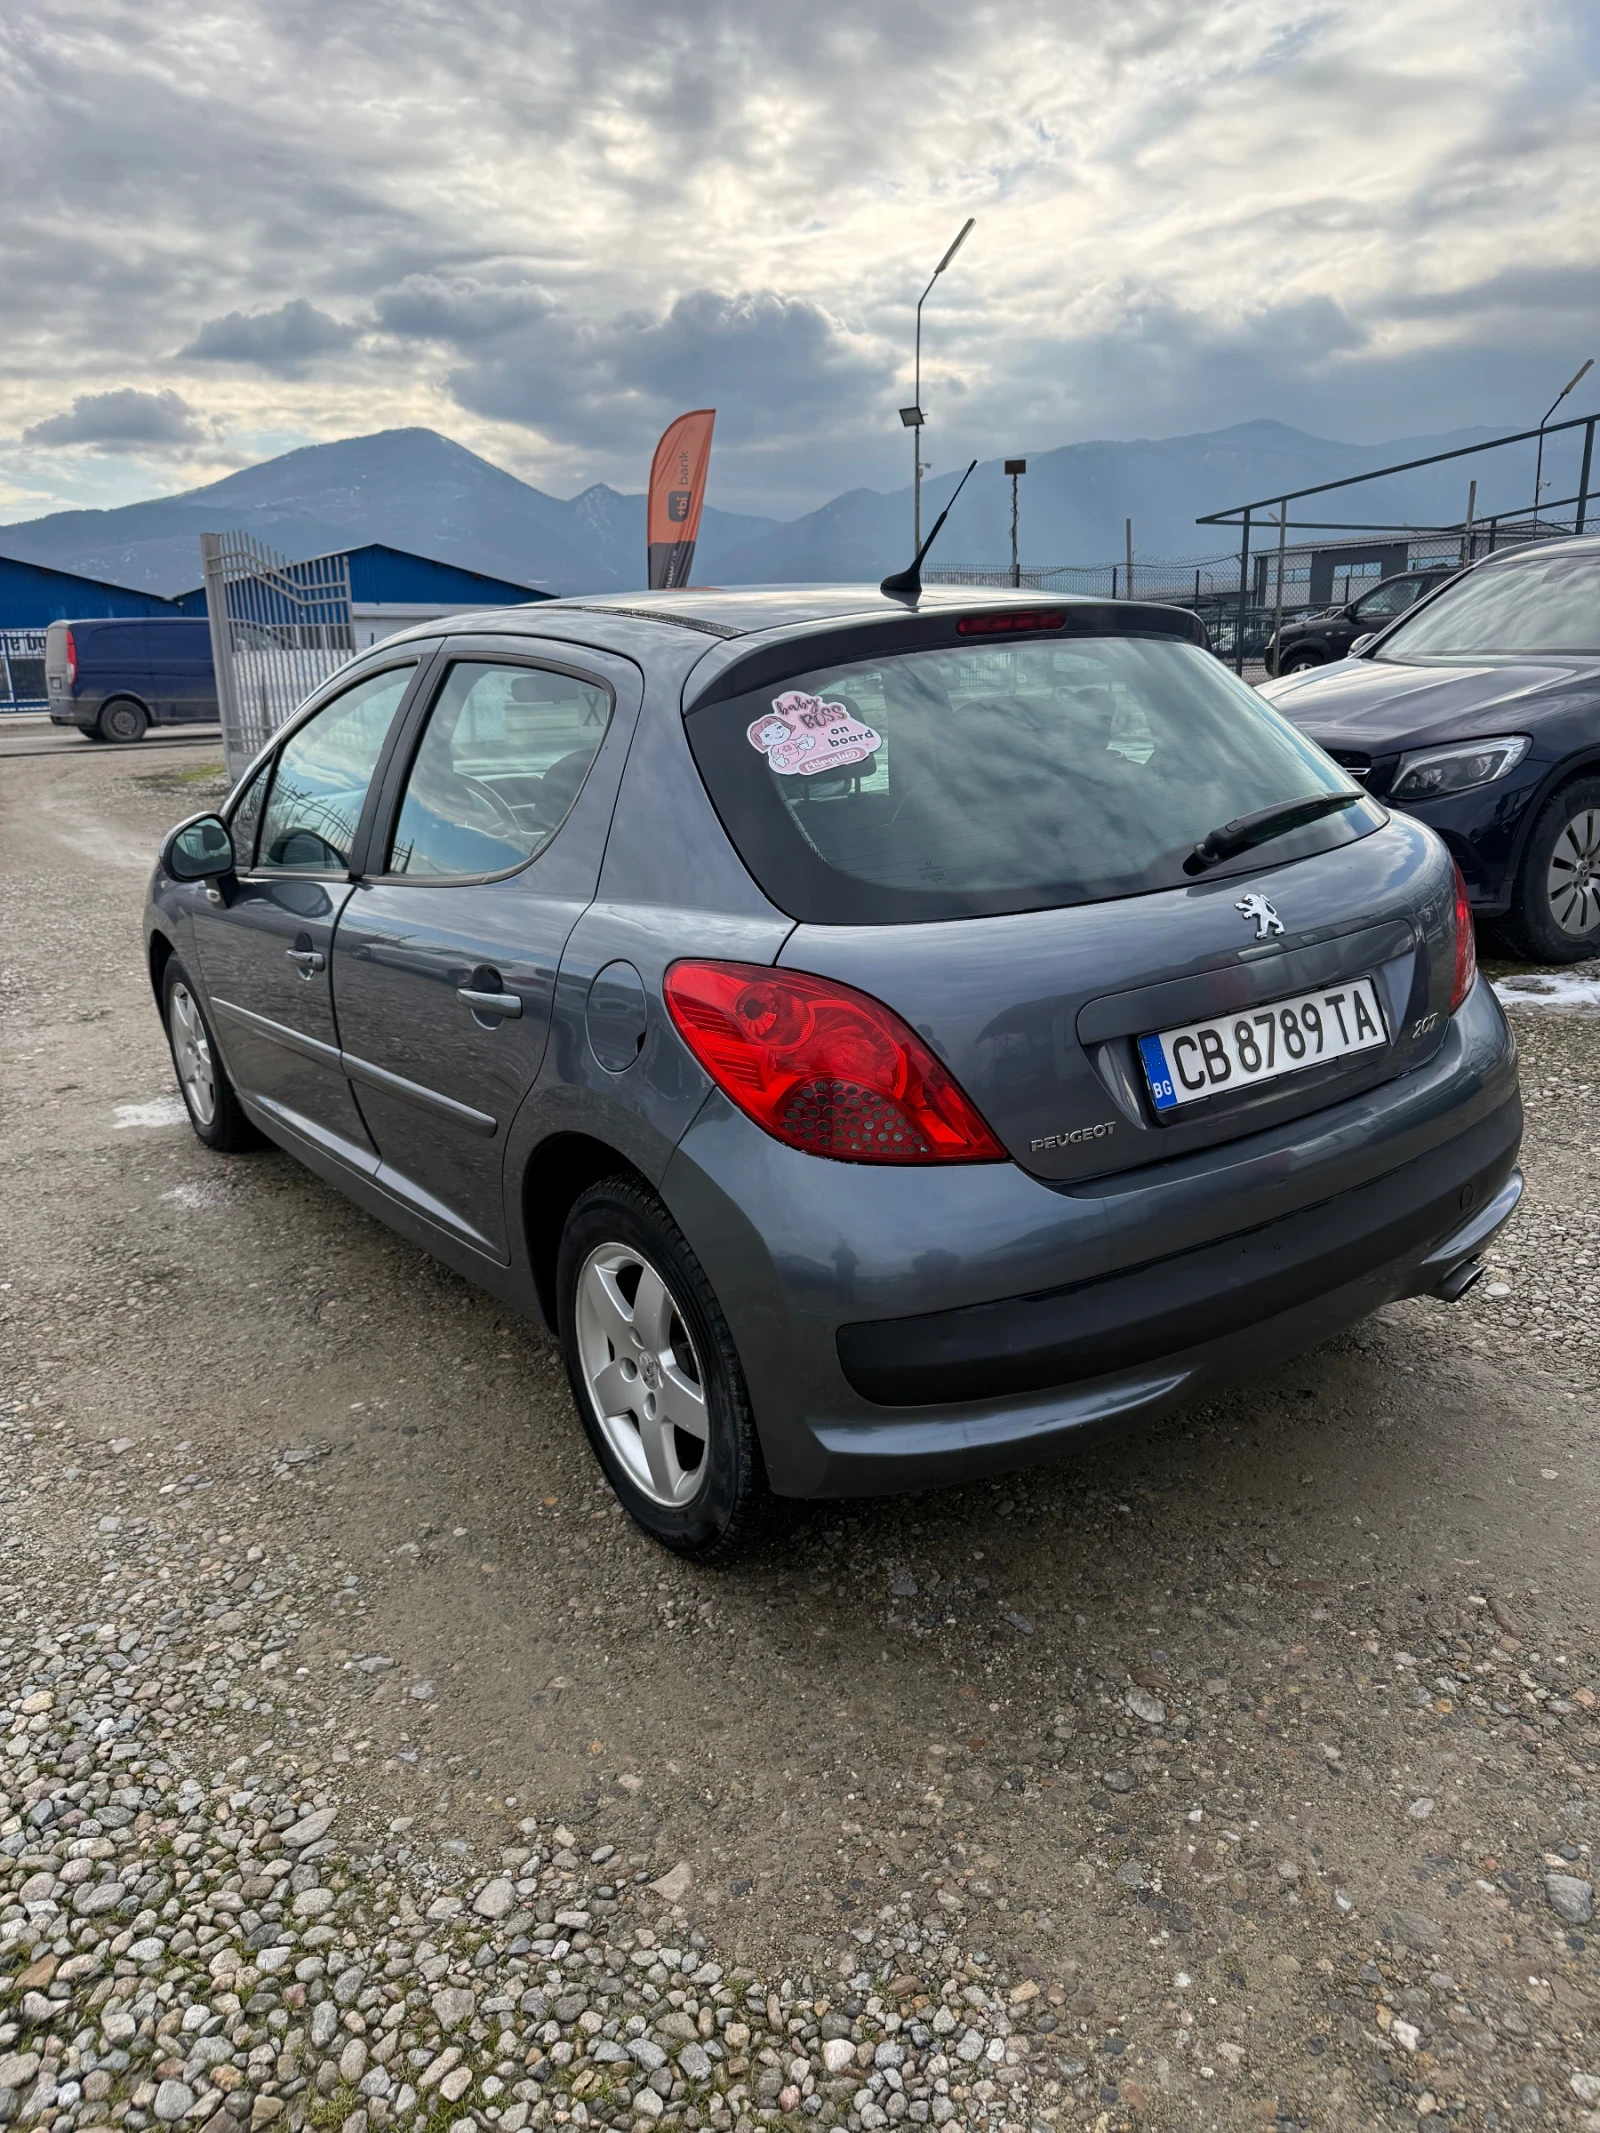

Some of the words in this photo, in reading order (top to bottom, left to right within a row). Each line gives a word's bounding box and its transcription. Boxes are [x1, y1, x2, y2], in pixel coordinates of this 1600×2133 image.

[677, 450, 689, 486] bank
[775, 695, 820, 715] baby
[798, 704, 848, 729] BOSS
[829, 730, 874, 747] board
[831, 726, 849, 735] on
[1234, 1002, 1325, 1073] 8789
[1411, 1012, 1439, 1039] 207
[1152, 1079, 1173, 1099] BG
[1030, 1121, 1117, 1152] PEUGEOT
